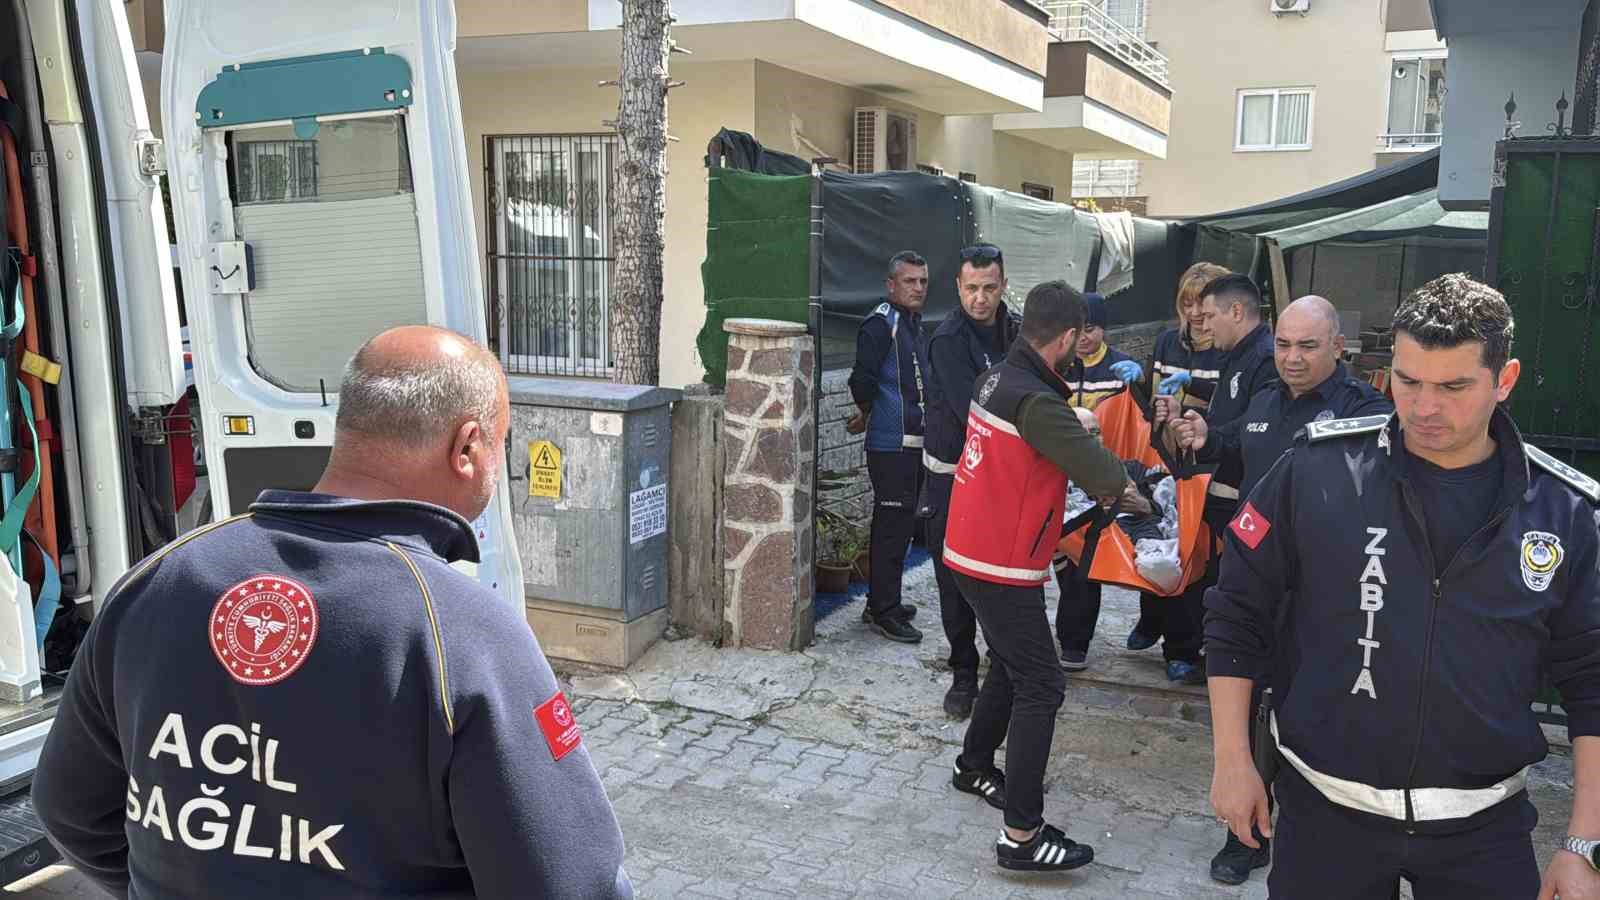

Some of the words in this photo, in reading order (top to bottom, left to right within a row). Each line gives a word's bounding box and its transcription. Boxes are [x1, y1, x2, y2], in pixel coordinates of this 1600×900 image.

[1351, 526, 1388, 700] ZABITA
[149, 712, 298, 793] ACİL
[126, 775, 346, 871] SAĞLIK
